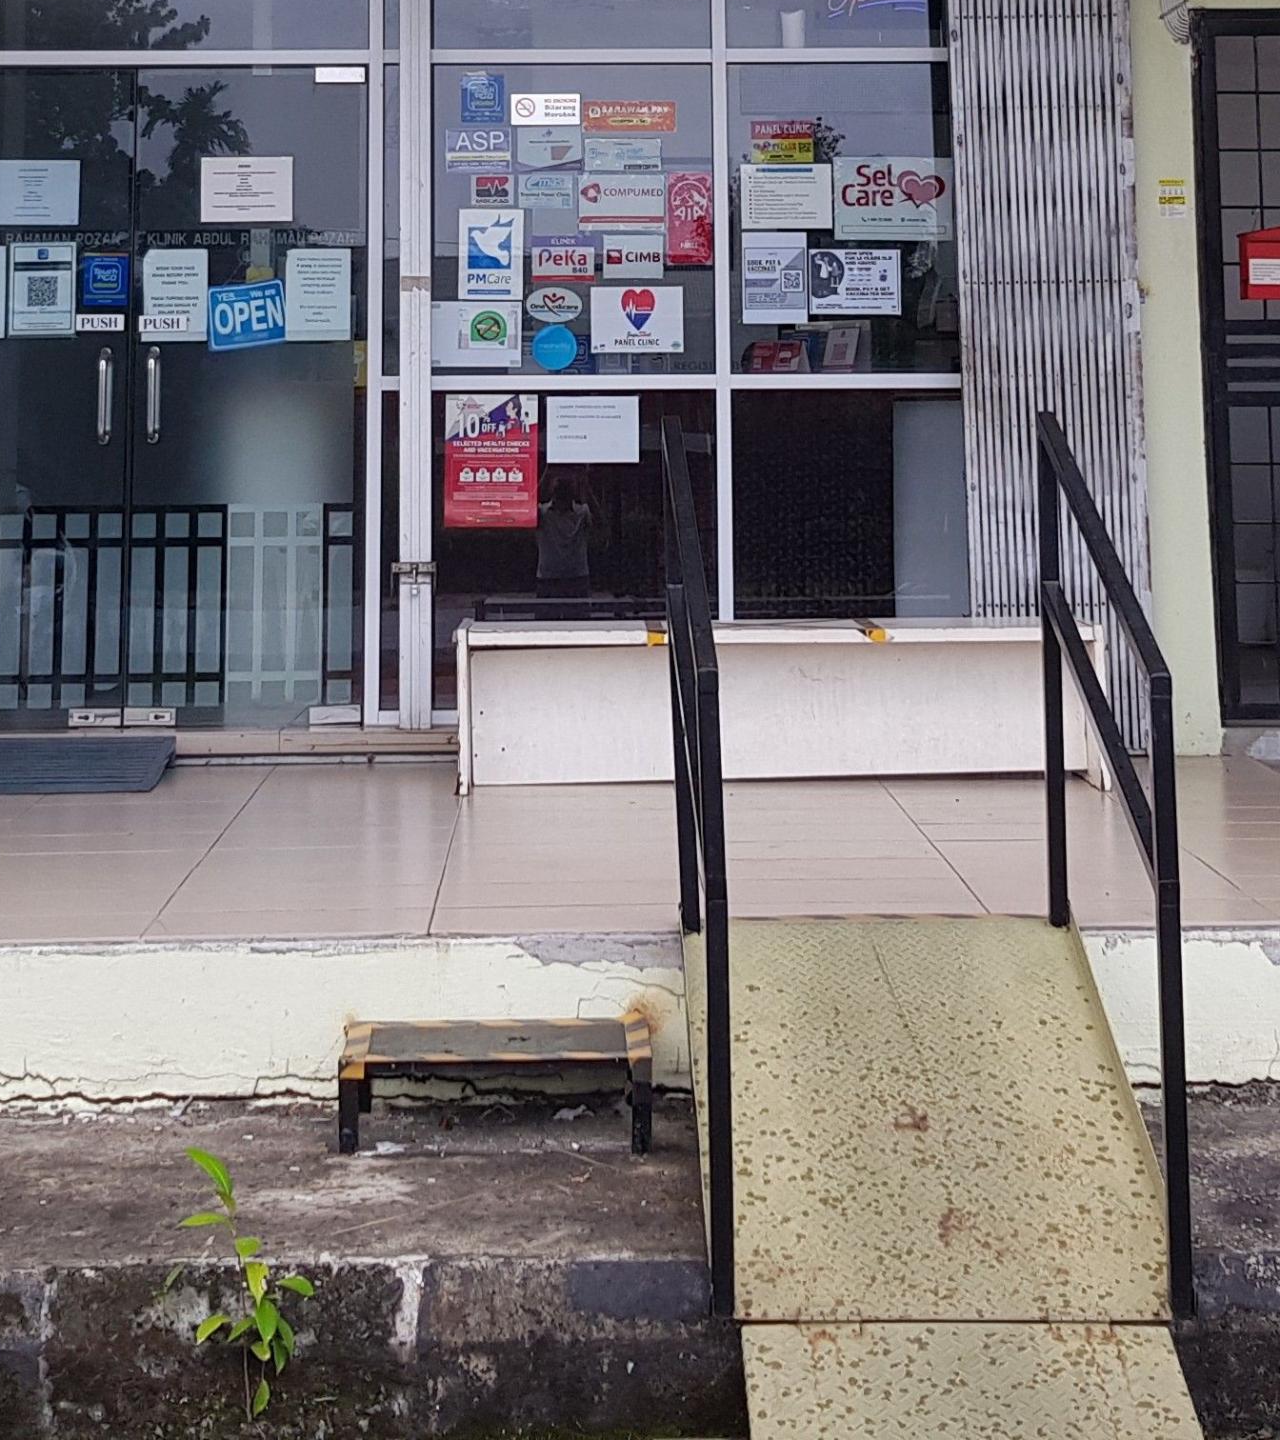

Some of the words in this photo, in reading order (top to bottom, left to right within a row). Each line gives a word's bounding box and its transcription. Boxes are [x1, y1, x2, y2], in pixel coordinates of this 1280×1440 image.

[754, 124, 781, 134] PANEL
[456, 131, 505, 151] ASP
[855, 164, 898, 187] Sel
[603, 188, 664, 197] COMPUMED
[841, 184, 894, 207] Care
[147, 233, 187, 245] KLINIK
[193, 233, 235, 245] ABDUL
[538, 248, 587, 267] PeKa
[625, 250, 661, 263] CIMB
[467, 273, 511, 285] PMCare
[250, 289, 264, 298] We
[214, 295, 284, 335] OPEN
[81, 317, 118, 329] PUSH
[143, 317, 181, 330] PUSH
[614, 338, 636, 346] PANEL
[638, 338, 660, 346] CLINIC
[481, 423, 497, 433] OFF
